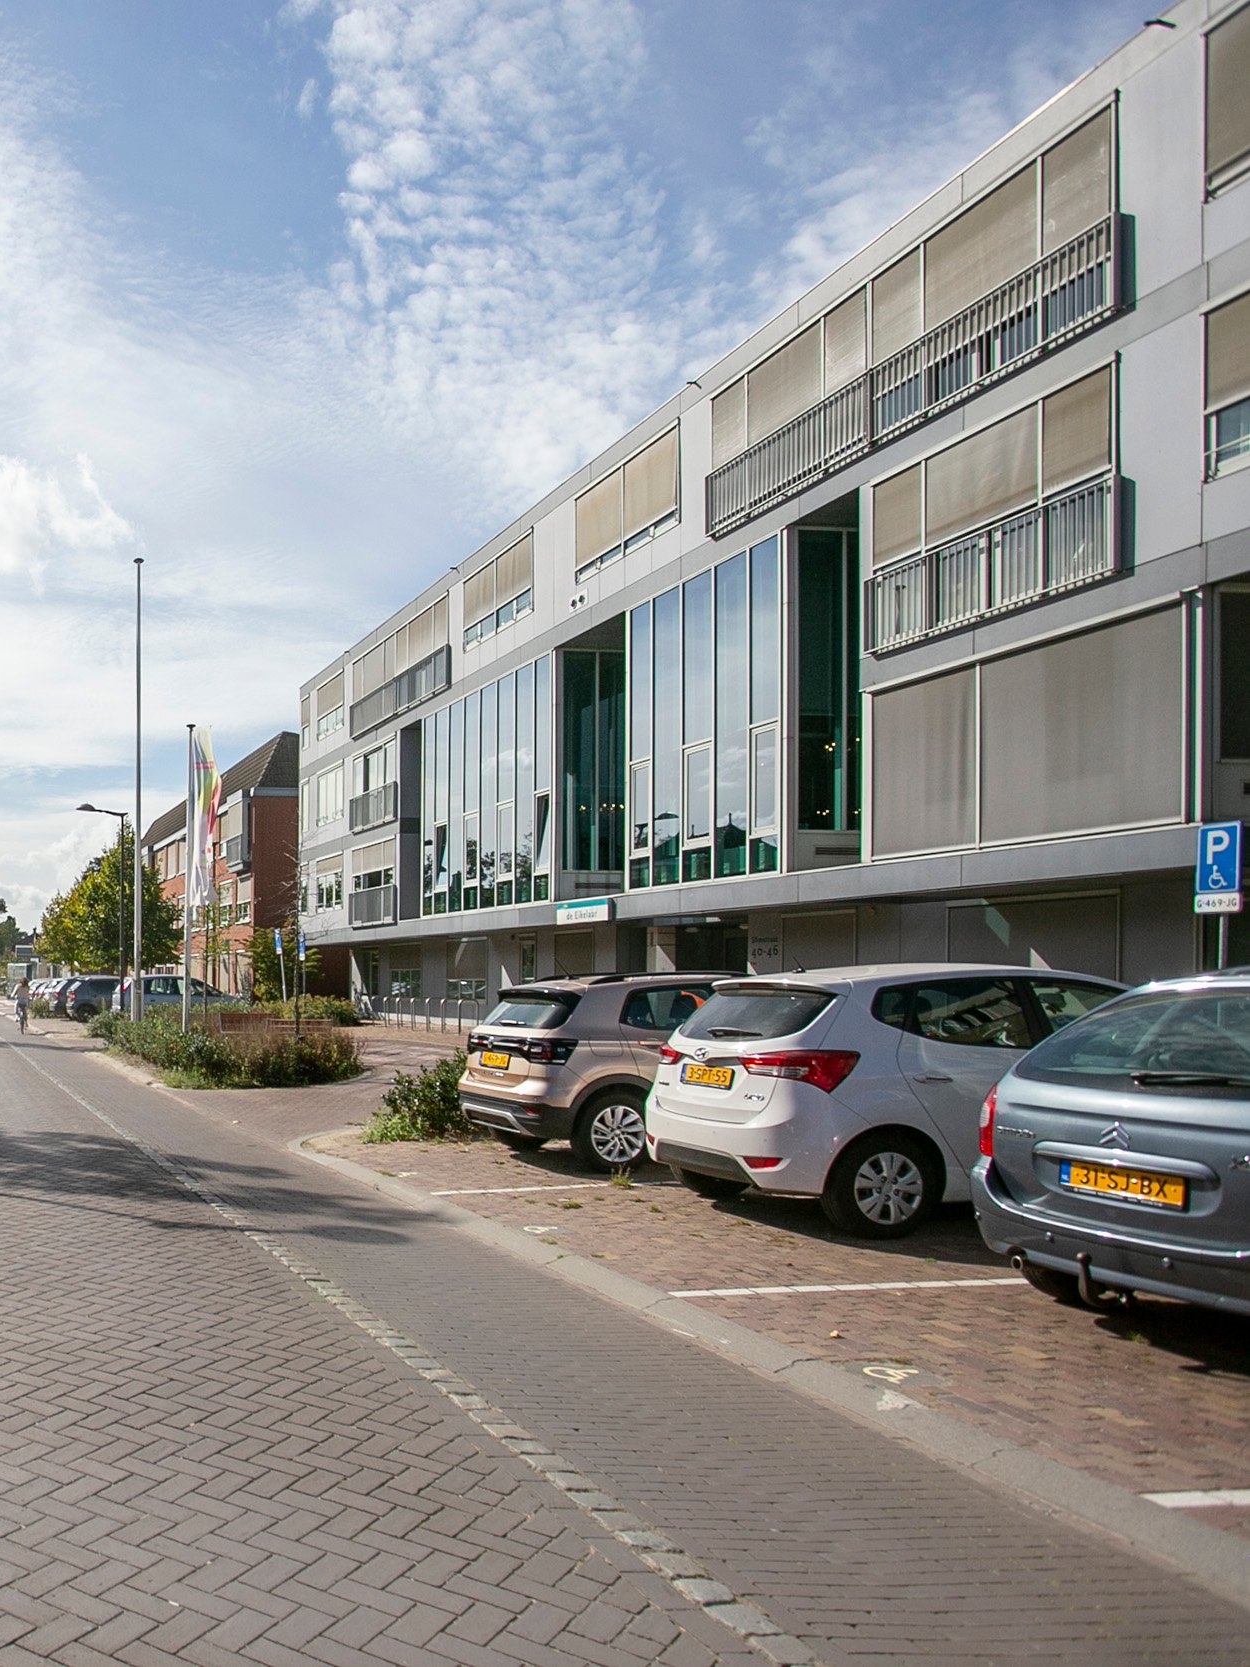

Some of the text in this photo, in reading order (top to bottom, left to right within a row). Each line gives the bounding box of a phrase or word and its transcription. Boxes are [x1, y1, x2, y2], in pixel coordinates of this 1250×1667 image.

[1206, 829, 1230, 865] P
[1196, 898, 1237, 909] G-469-JG
[566, 909, 598, 920] de Eikelaar
[751, 945, 779, 959] 40-46
[688, 1067, 728, 1083] 3-SPT-55
[1079, 1166, 1168, 1199] 31-SJ-BX
